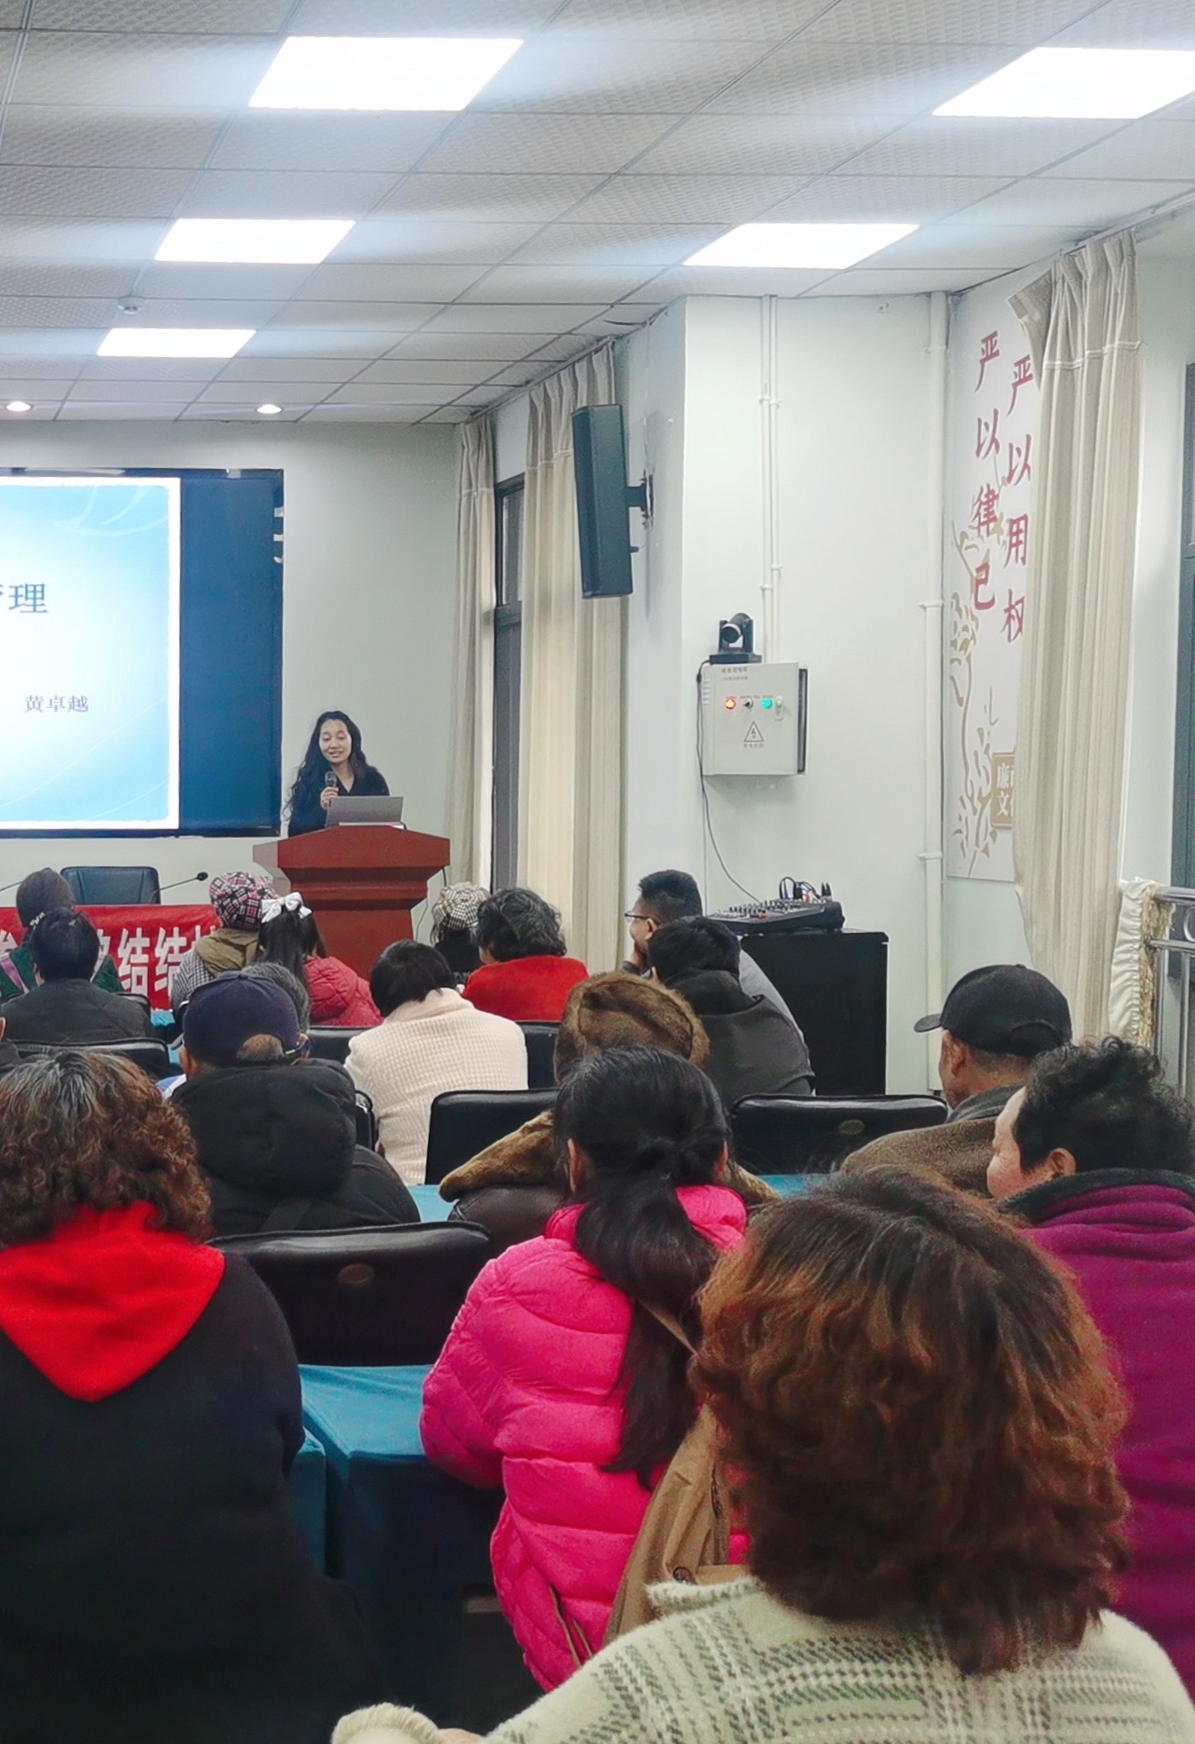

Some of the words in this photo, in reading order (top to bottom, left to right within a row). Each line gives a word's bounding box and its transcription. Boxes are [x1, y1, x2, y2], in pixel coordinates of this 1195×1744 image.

[973, 331, 1000, 610] 严以律己
[1002, 355, 1033, 643] 严以用权
[23, 694, 89, 713] 黄卓越
